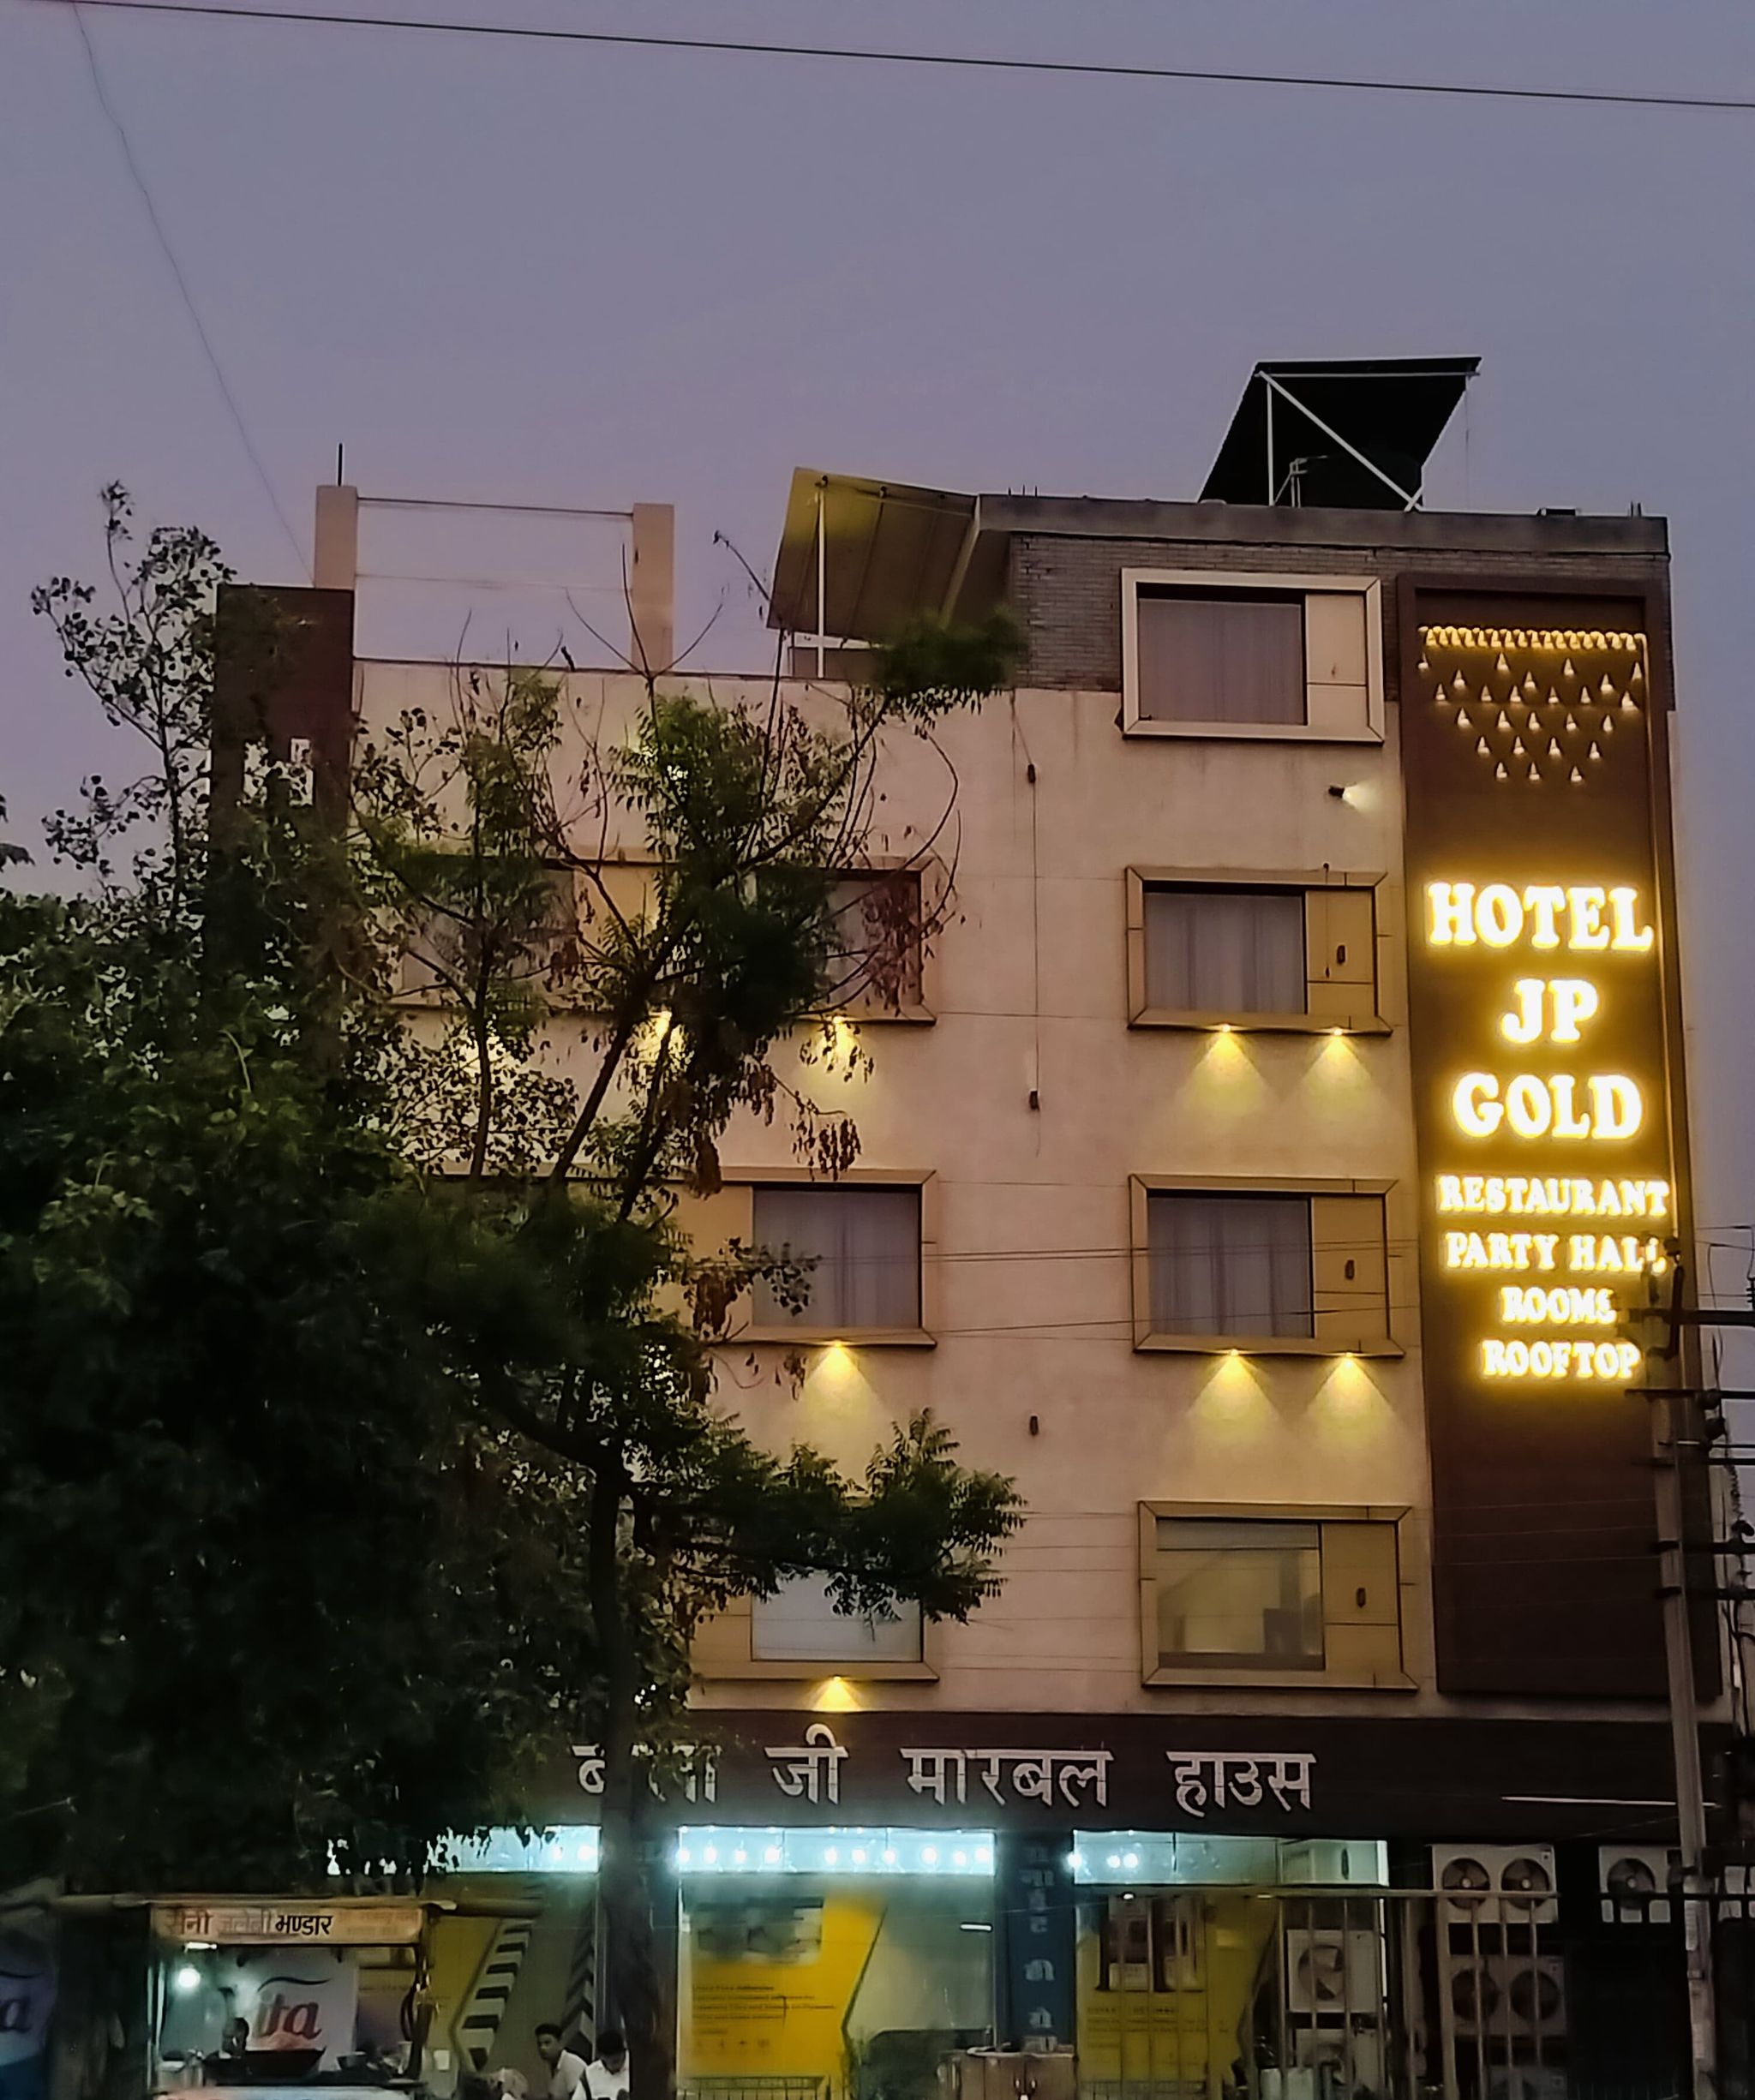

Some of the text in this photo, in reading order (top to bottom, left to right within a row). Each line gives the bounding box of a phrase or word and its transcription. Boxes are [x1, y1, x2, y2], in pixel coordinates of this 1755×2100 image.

[1428, 882, 1654, 952] HOTEL
[1500, 978, 1598, 1044] JP
[1452, 1073, 1643, 1140] GOLD
[1438, 1176, 1670, 1217] RESTAURANT
[1445, 1232, 1560, 1271] PARTY
[1500, 1287, 1618, 1325] ROOMS
[1482, 1340, 1641, 1379] ROOFTOP
[764, 1723, 849, 1805] जी
[900, 1748, 1115, 1808] मारबल
[1165, 1751, 1317, 1818] हाउस
[275, 1915, 333, 1936] भण्डार
